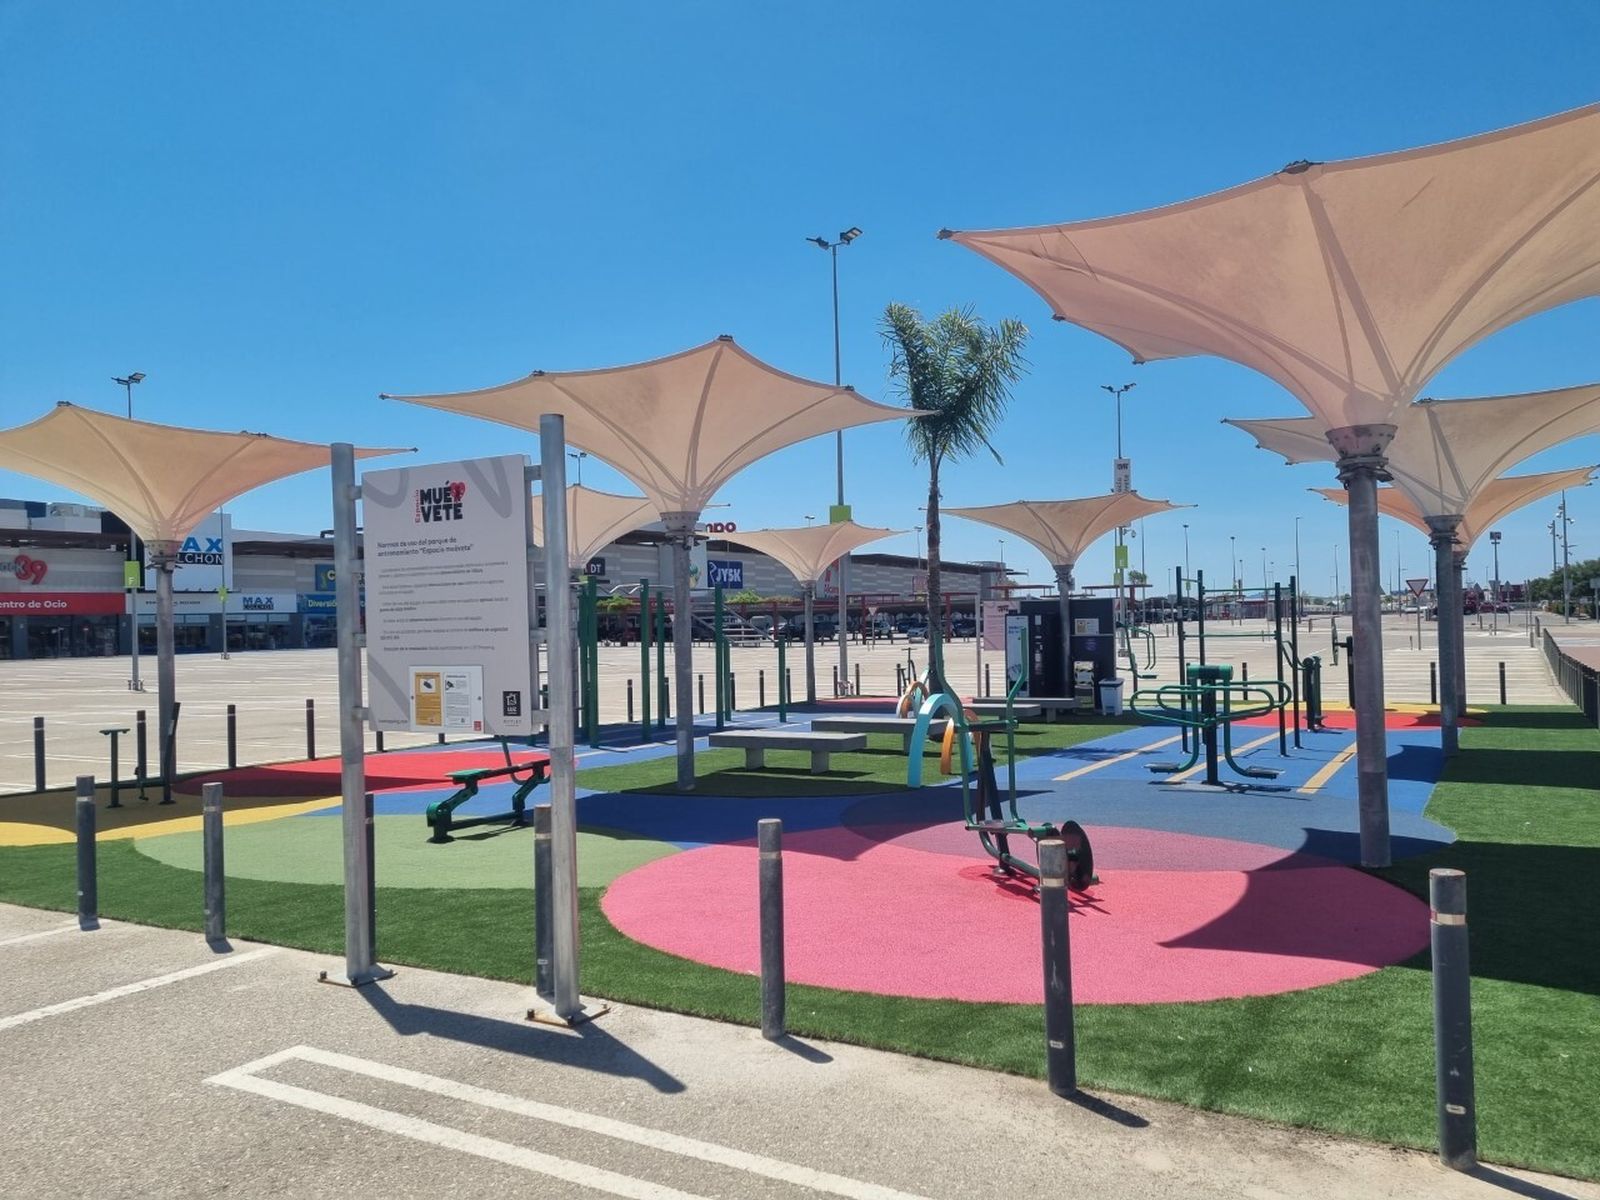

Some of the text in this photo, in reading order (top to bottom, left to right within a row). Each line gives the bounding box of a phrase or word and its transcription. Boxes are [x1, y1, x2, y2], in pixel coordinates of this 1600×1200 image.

[421, 502, 463, 523] VETE
[182, 537, 223, 552] AX
[716, 568, 742, 582] JYSK
[0, 600, 67, 608] entro de Ocio
[243, 596, 273, 604] MAX
[308, 599, 337, 608] Diversió
